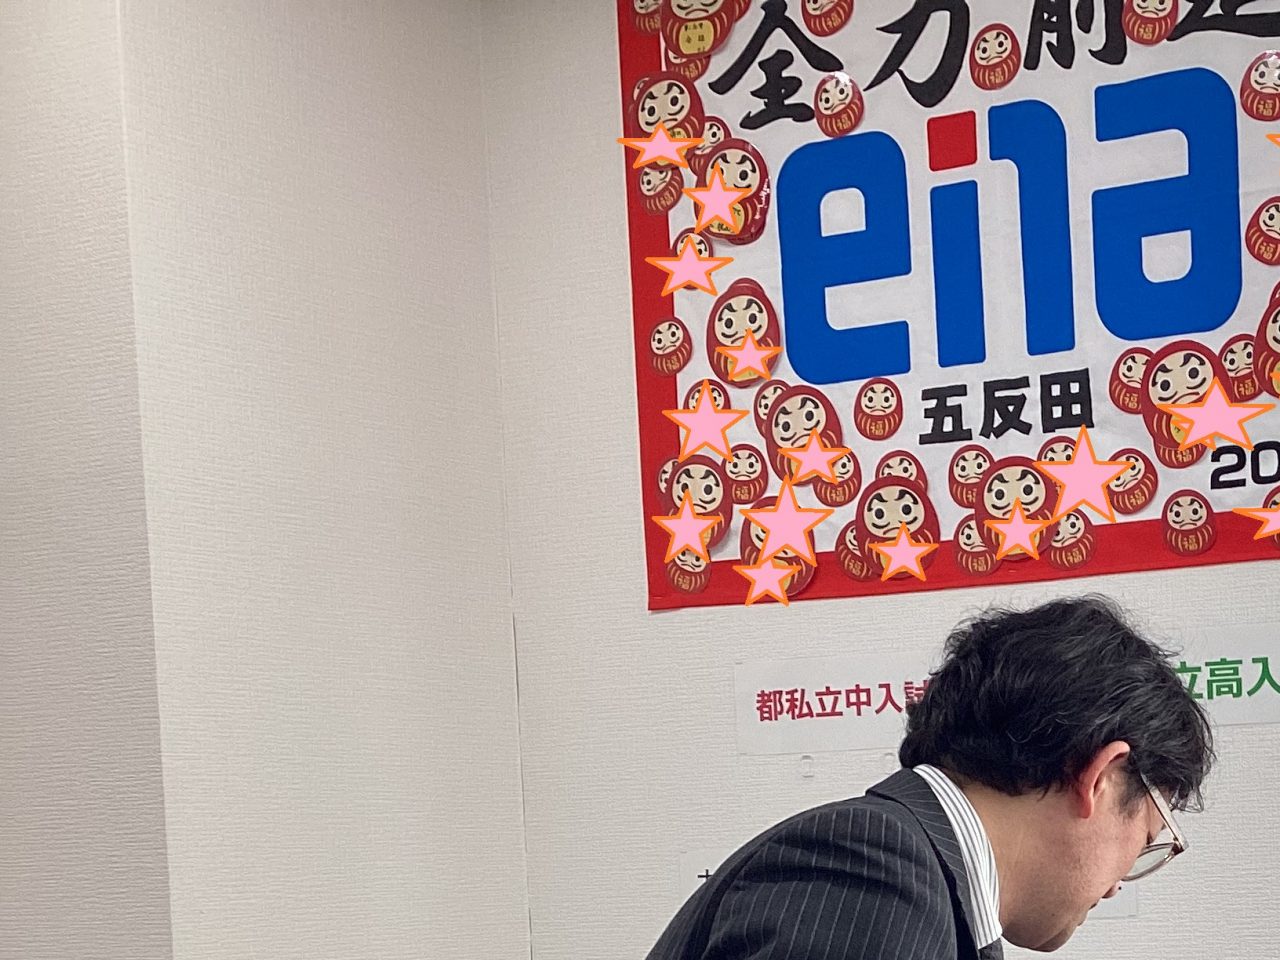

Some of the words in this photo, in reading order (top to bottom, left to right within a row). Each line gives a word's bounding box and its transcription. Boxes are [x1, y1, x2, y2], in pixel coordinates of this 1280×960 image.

[1138, 23, 1154, 40] 福
[1257, 99, 1274, 116] 福
[1260, 242, 1276, 260] 福
[919, 368, 1095, 445] 五反田
[1124, 392, 1139, 409] 福
[870, 420, 885, 436] 福
[1130, 489, 1146, 507] 福
[1181, 535, 1198, 551] 福
